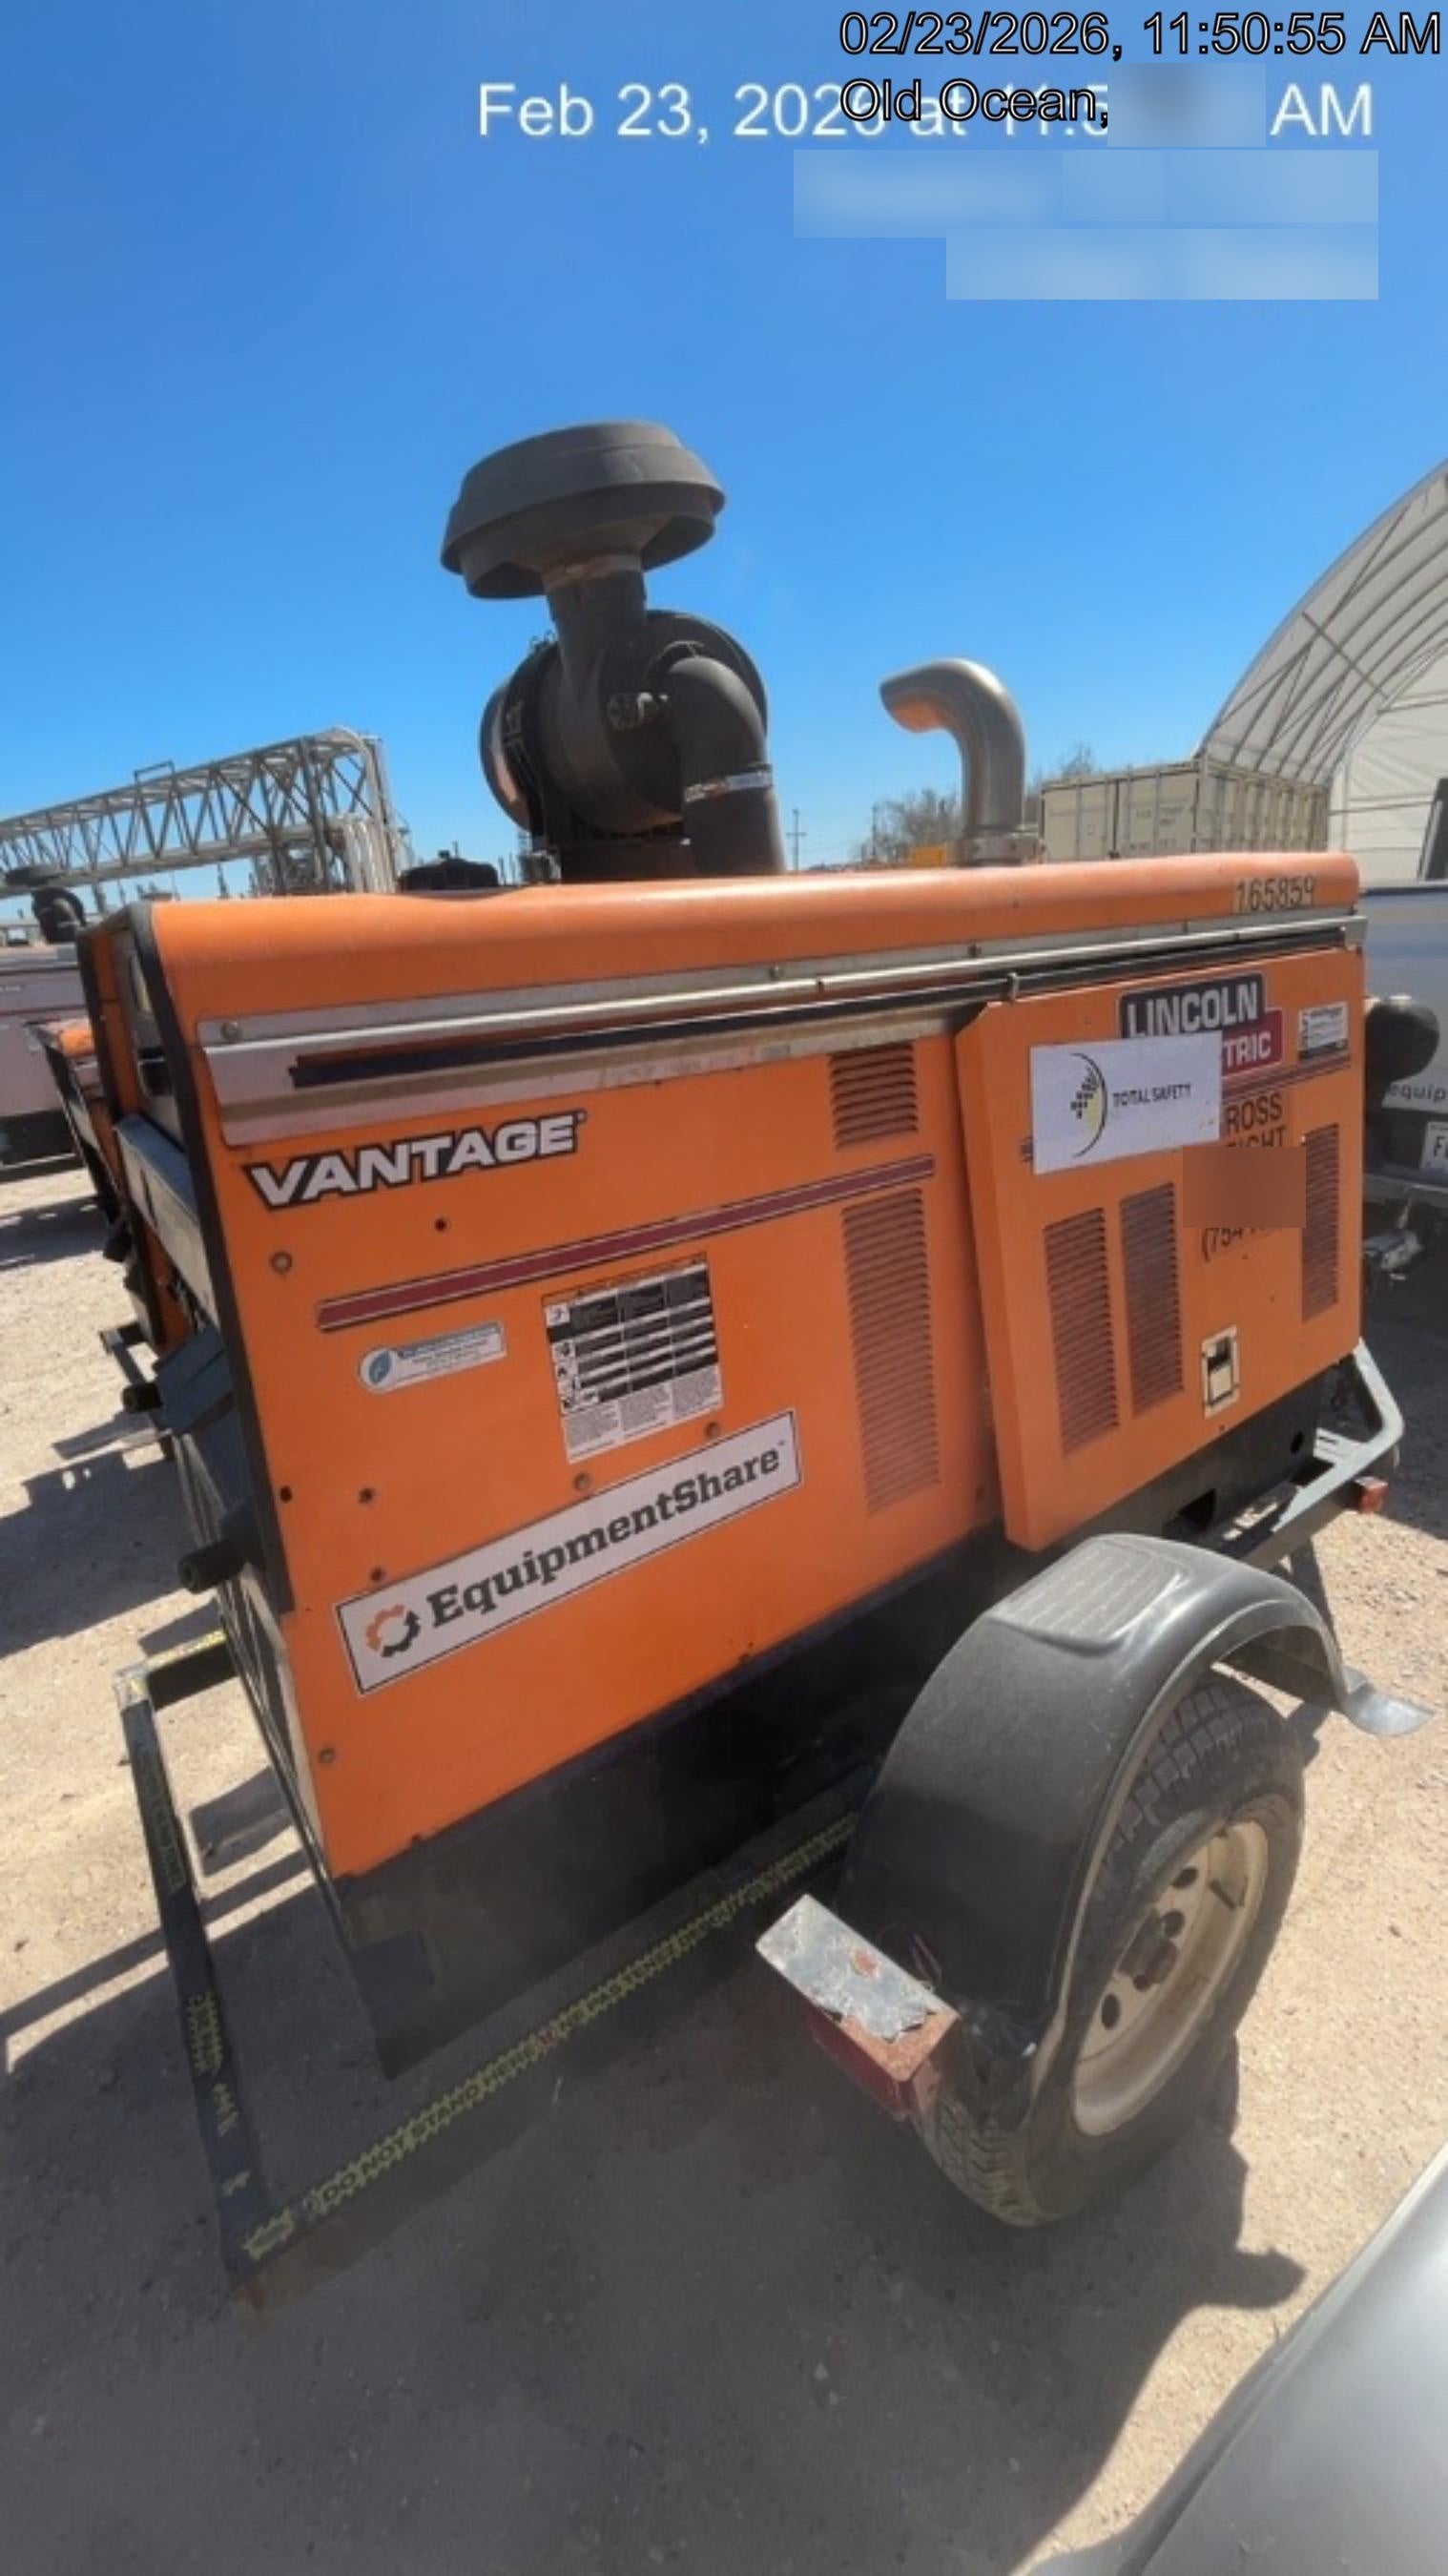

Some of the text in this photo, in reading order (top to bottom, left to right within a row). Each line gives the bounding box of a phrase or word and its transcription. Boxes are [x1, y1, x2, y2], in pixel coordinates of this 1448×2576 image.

[1127, 982, 1258, 1037] LINCOLN
[1113, 1090, 1150, 1108] TOTAL
[246, 1114, 577, 1209] VANTAGE
[427, 1446, 780, 1630] EquipmentShare
